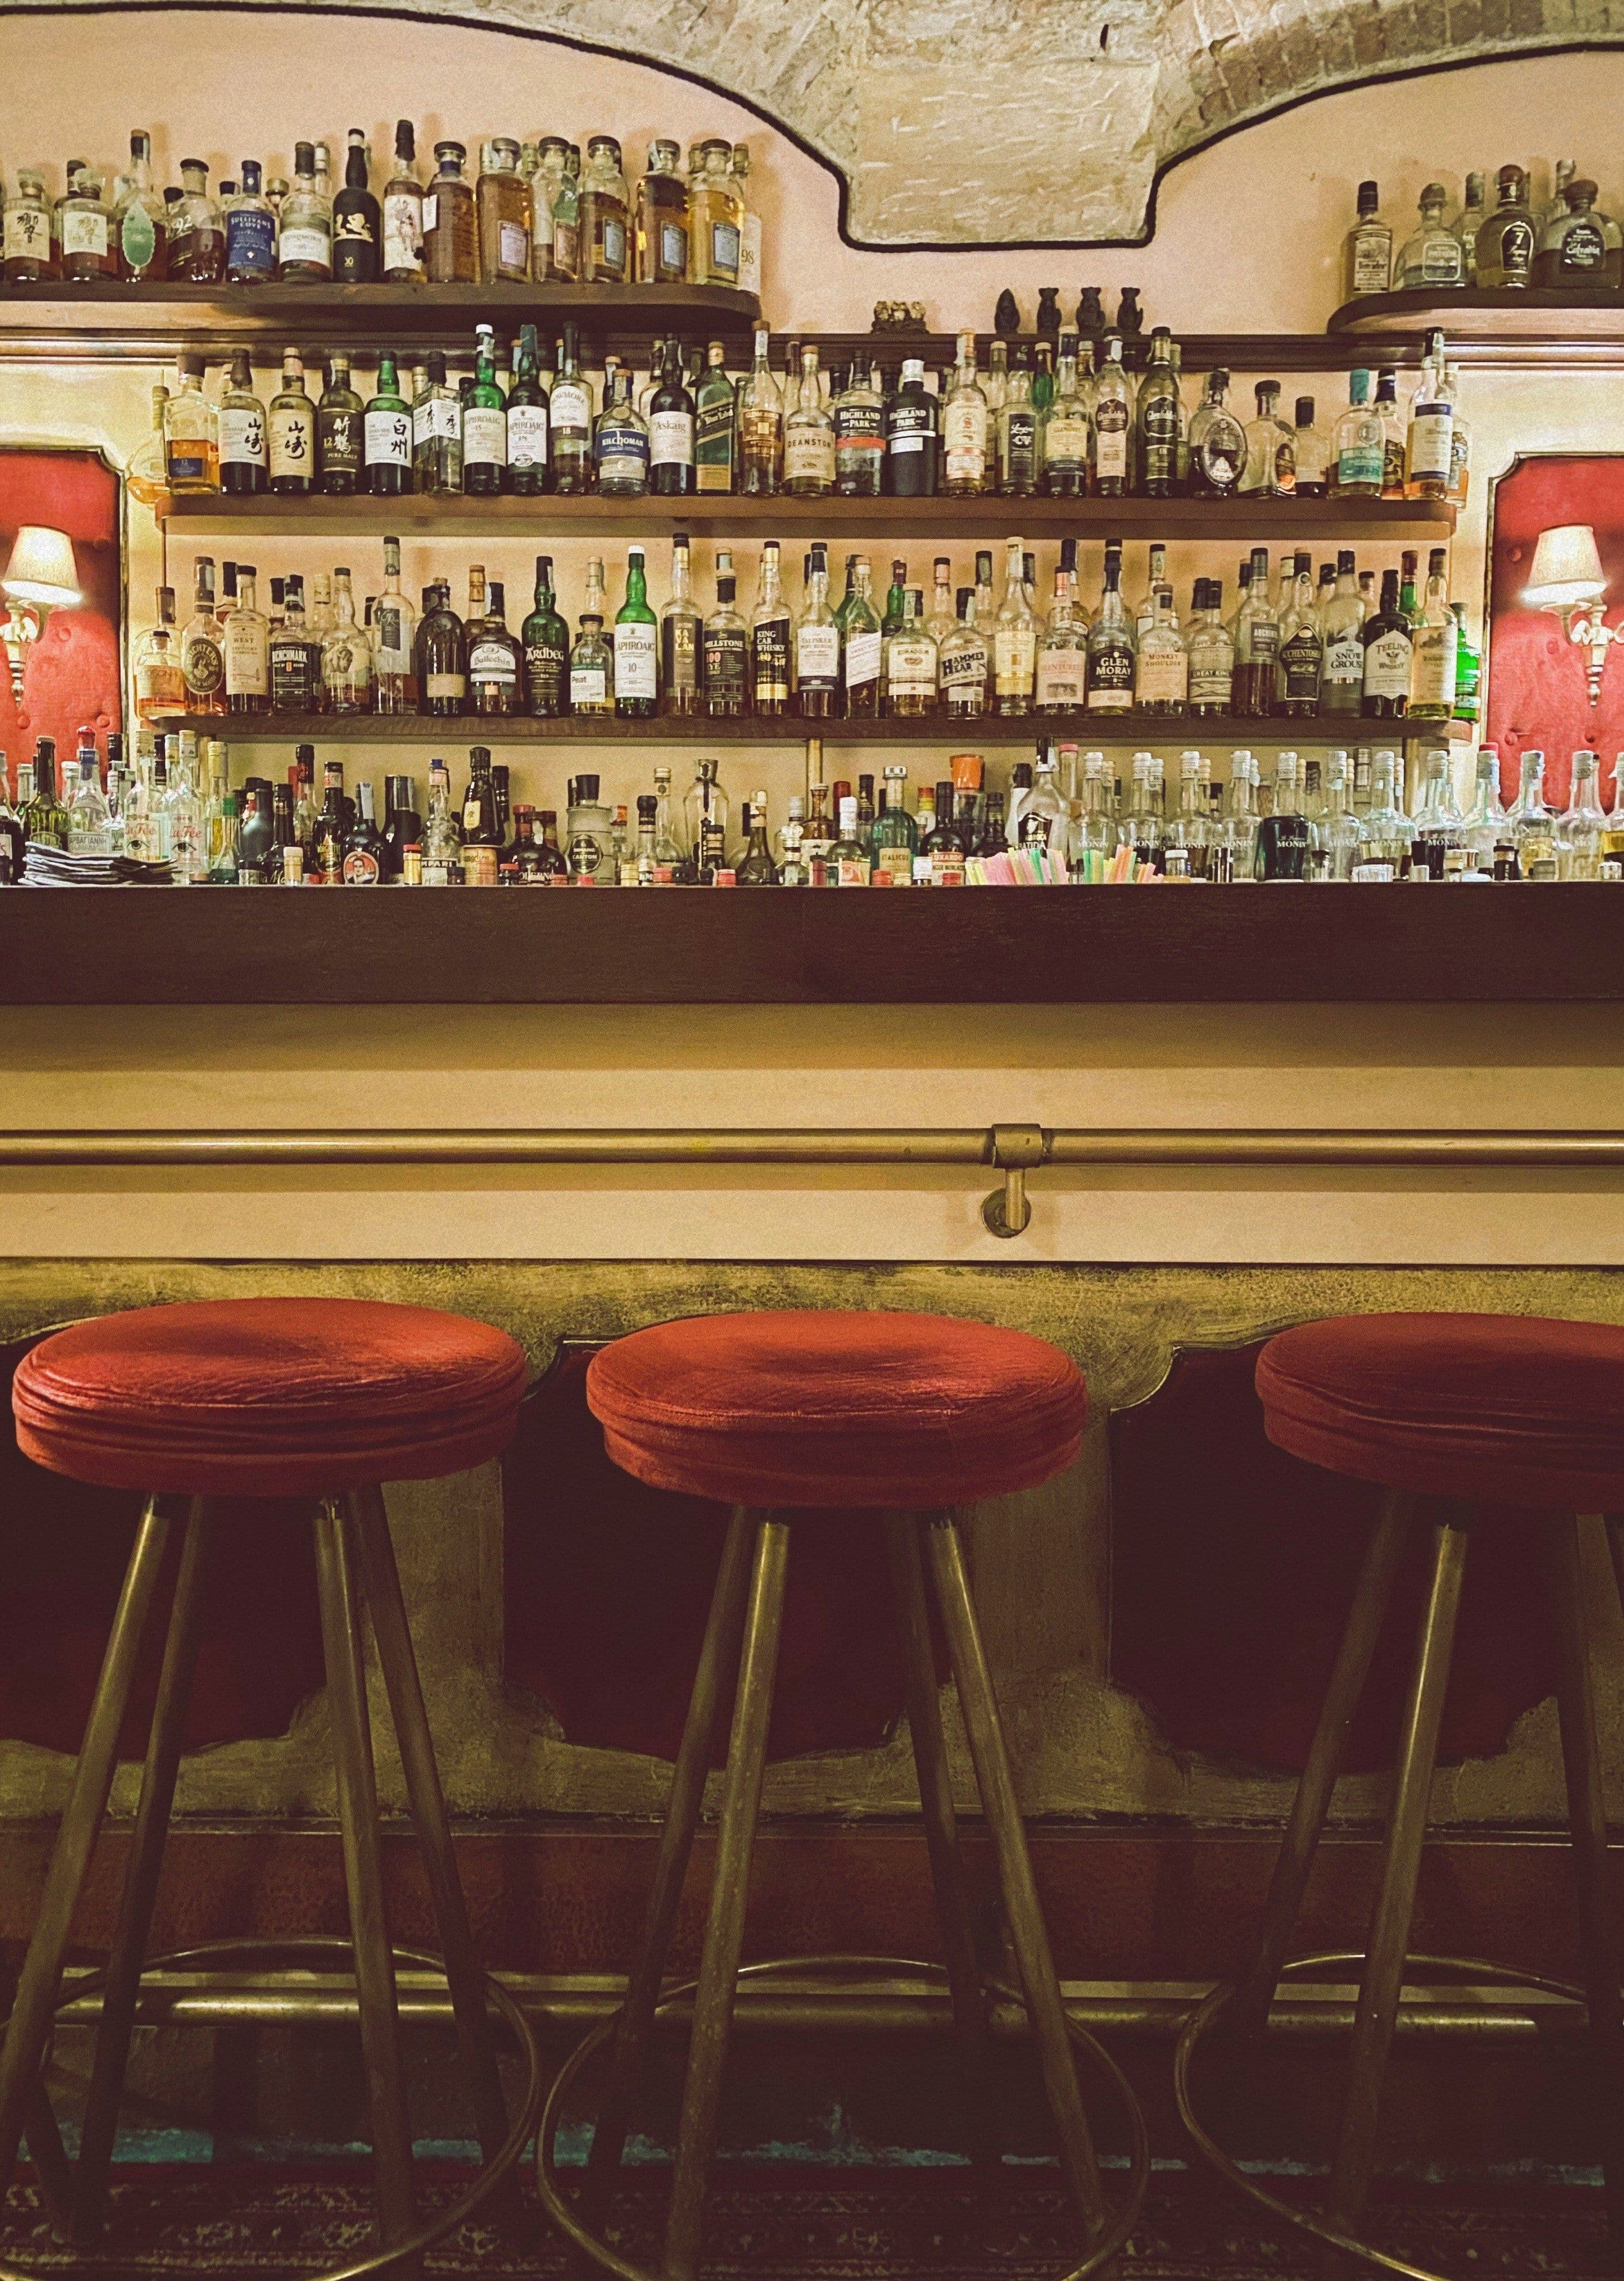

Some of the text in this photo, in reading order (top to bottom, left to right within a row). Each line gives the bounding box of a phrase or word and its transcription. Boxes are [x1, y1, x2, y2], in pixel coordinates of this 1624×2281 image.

[840, 411, 881, 420] HIGHLAND
[889, 410, 927, 420] HIGHLAND
[466, 416, 501, 425] APHROAIG
[850, 419, 870, 428] PARK
[897, 418, 916, 427] PARK
[787, 438, 832, 449] DEANSTON
[617, 641, 656, 652] APHROAIG
[1376, 642, 1409, 655] TEELING
[525, 647, 565, 661] Ardbeg
[1100, 657, 1129, 666] GLEN
[628, 663, 637, 673] 10
[1096, 666, 1131, 675] MORAY
[1222, 840, 1255, 848] MONIN
